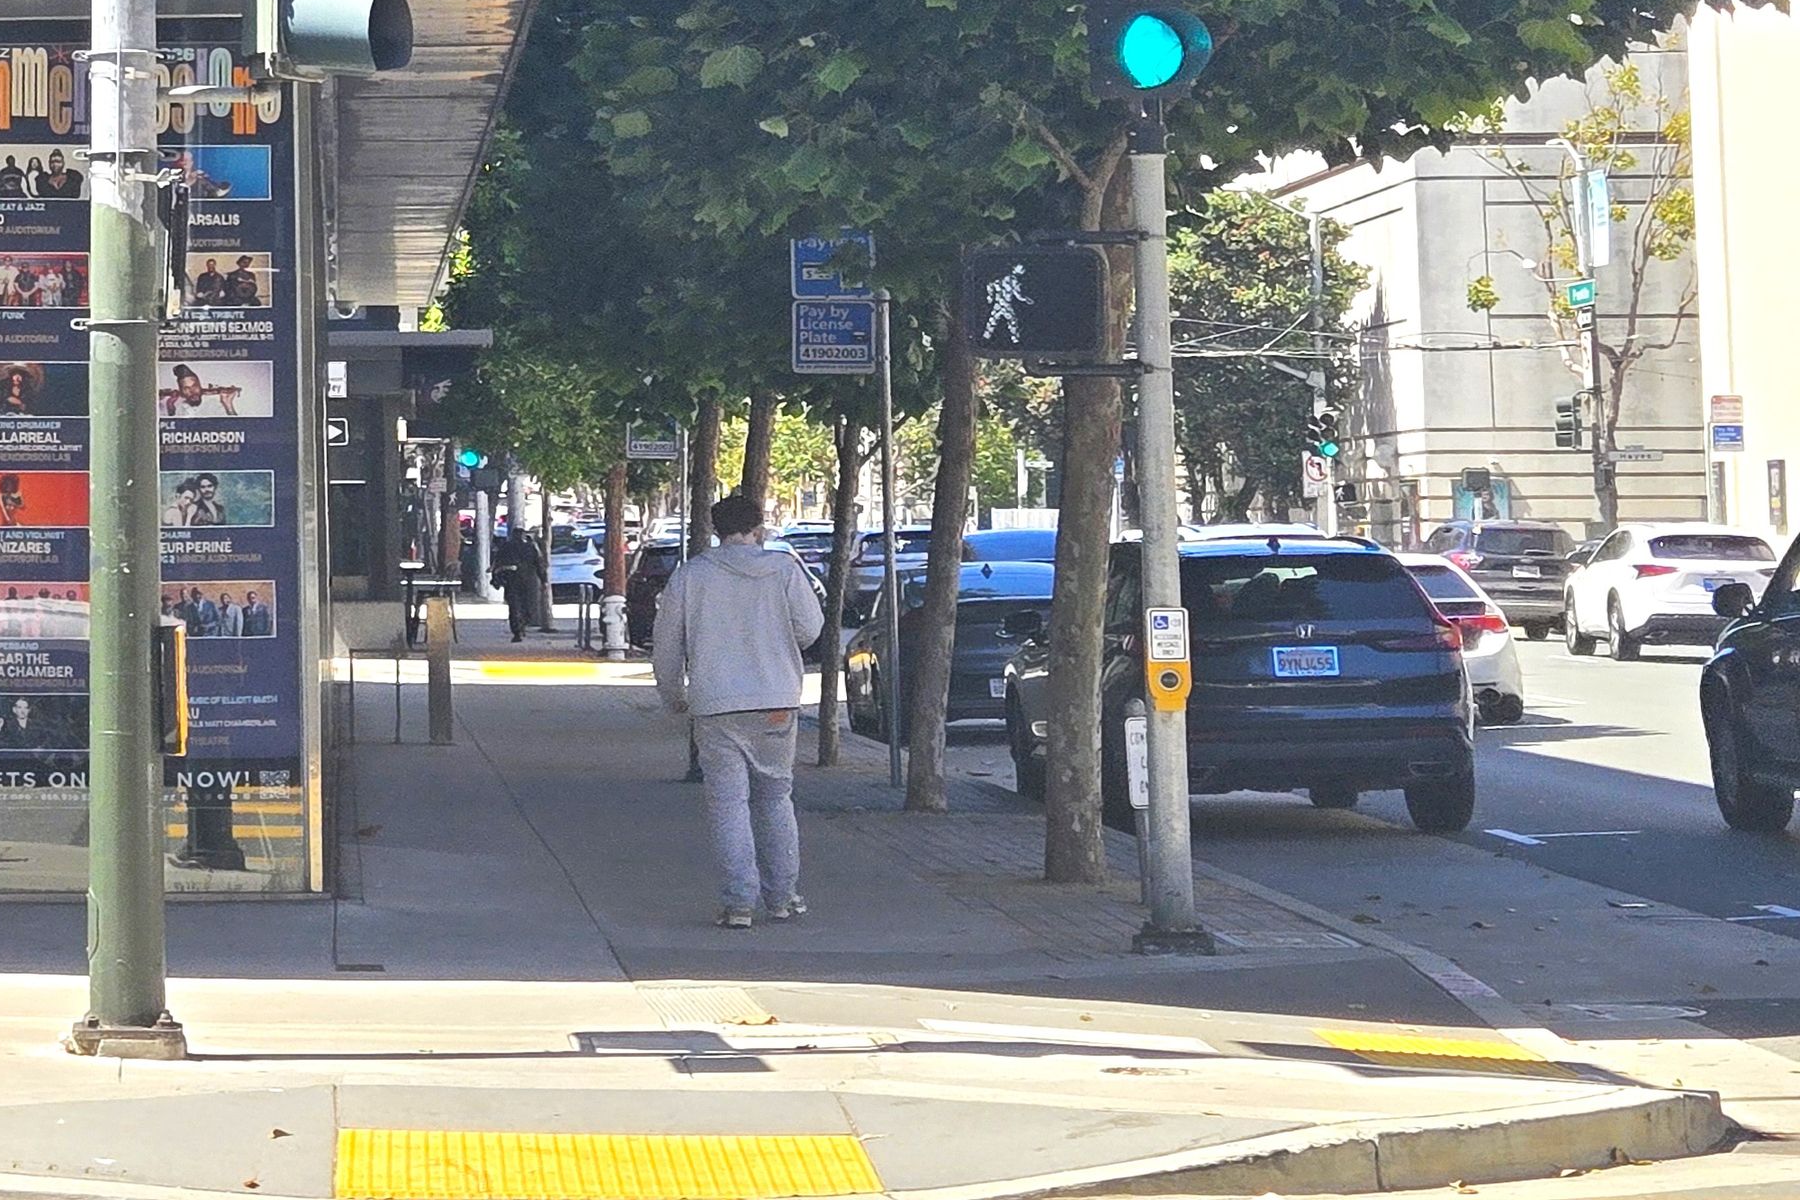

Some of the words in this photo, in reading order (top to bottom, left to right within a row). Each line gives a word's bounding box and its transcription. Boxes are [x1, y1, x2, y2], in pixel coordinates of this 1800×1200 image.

[25, 203, 46, 212] JAZZ
[187, 213, 241, 226] ARSALIS
[800, 304, 826, 320] Pay
[830, 303, 850, 320] by
[228, 321, 274, 334] SEXMOB
[800, 317, 854, 330] License
[800, 331, 837, 344] Plate
[802, 347, 867, 359] 41902003
[162, 431, 245, 444] RICHARDSON
[25, 652, 50, 665] THE
[6, 665, 73, 678] CHAMBER
[48, 771, 86, 788] ON
[177, 771, 250, 788] NOW!
